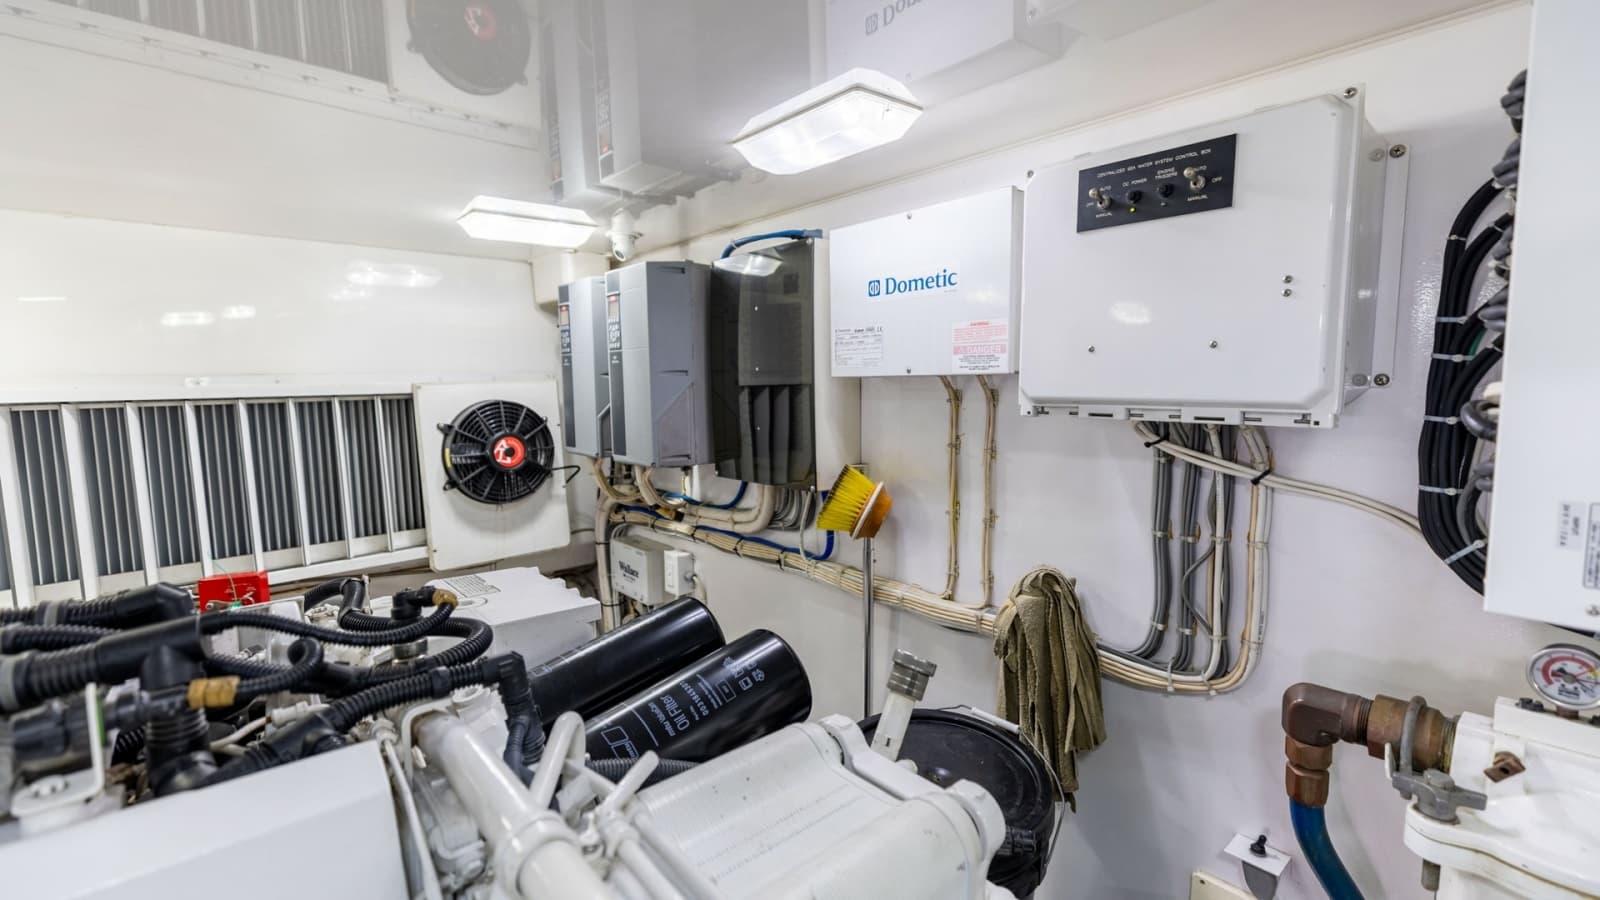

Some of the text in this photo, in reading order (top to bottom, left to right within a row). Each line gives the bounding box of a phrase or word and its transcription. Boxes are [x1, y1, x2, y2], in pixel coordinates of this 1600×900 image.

[1155, 157, 1173, 165] SYSTEM
[1175, 152, 1198, 161] CONTROL
[885, 268, 958, 295] Dometic
[661, 694, 690, 731] Oil Filter
